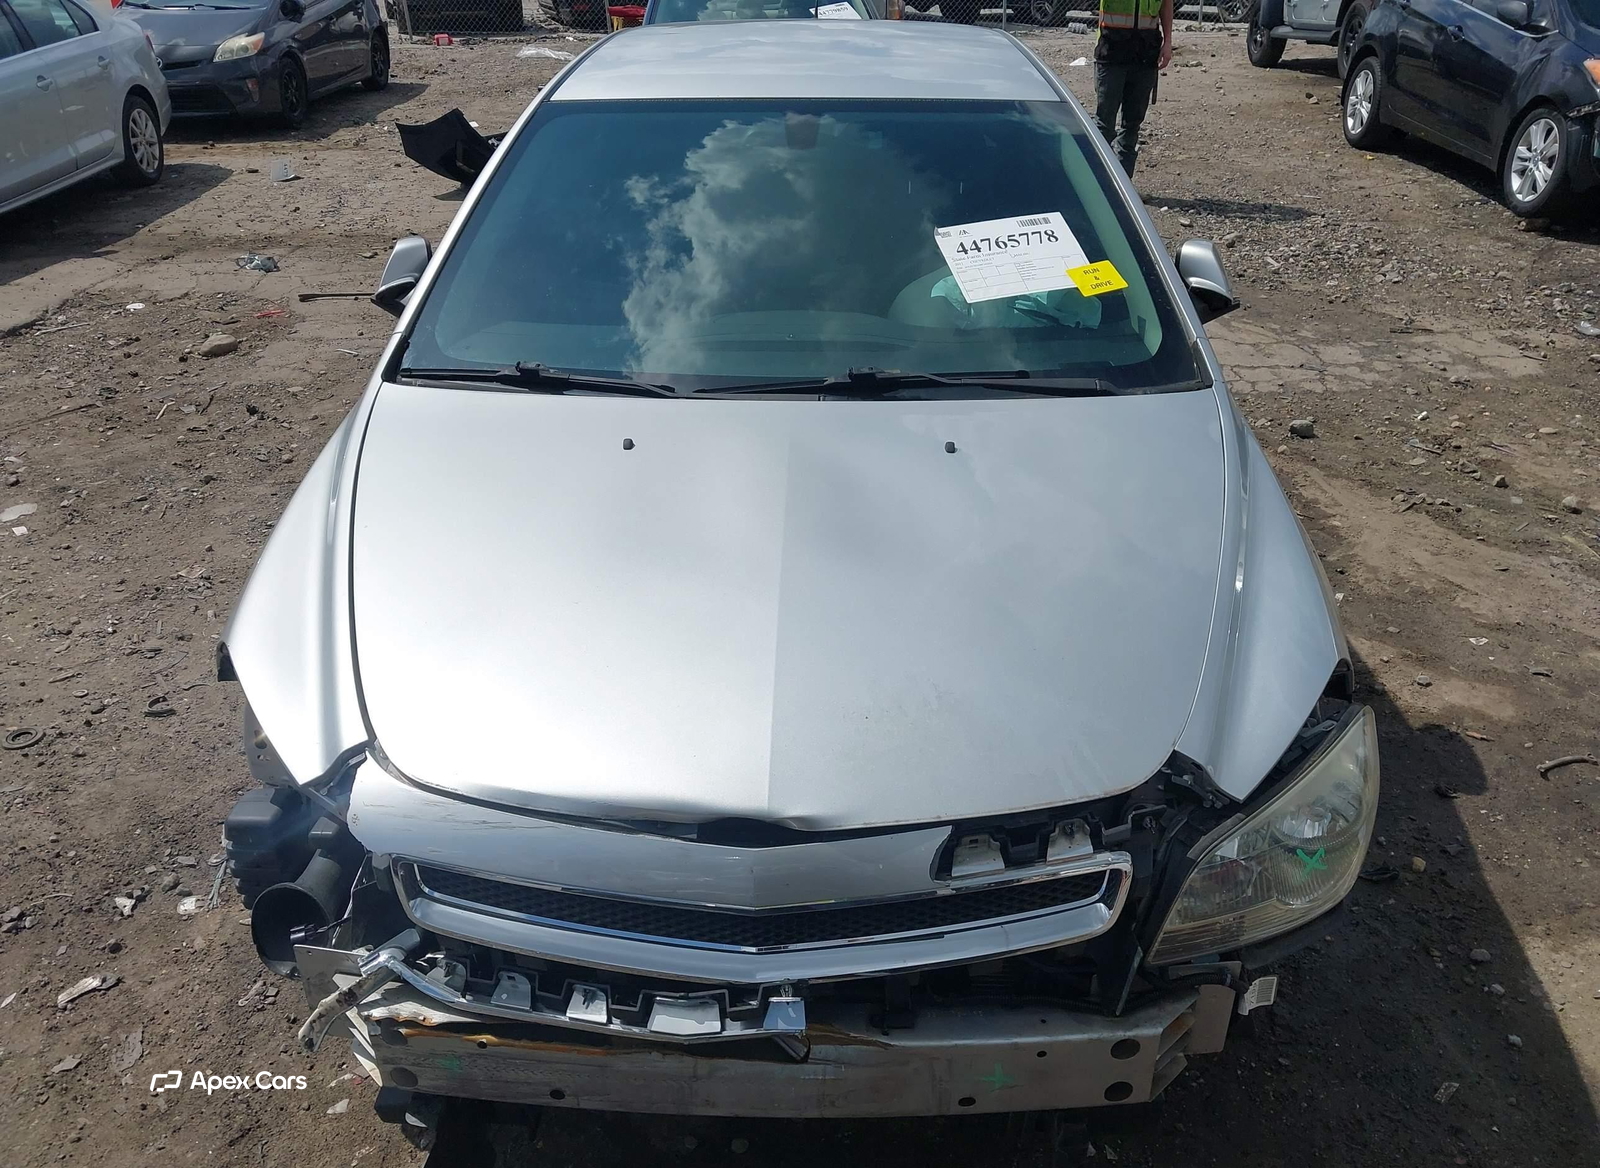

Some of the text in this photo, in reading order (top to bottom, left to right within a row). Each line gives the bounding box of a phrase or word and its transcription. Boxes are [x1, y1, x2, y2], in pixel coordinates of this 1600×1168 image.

[956, 229, 1059, 255] 44765778
[1082, 267, 1100, 276] RUN
[1090, 280, 1114, 290] DRIVE
